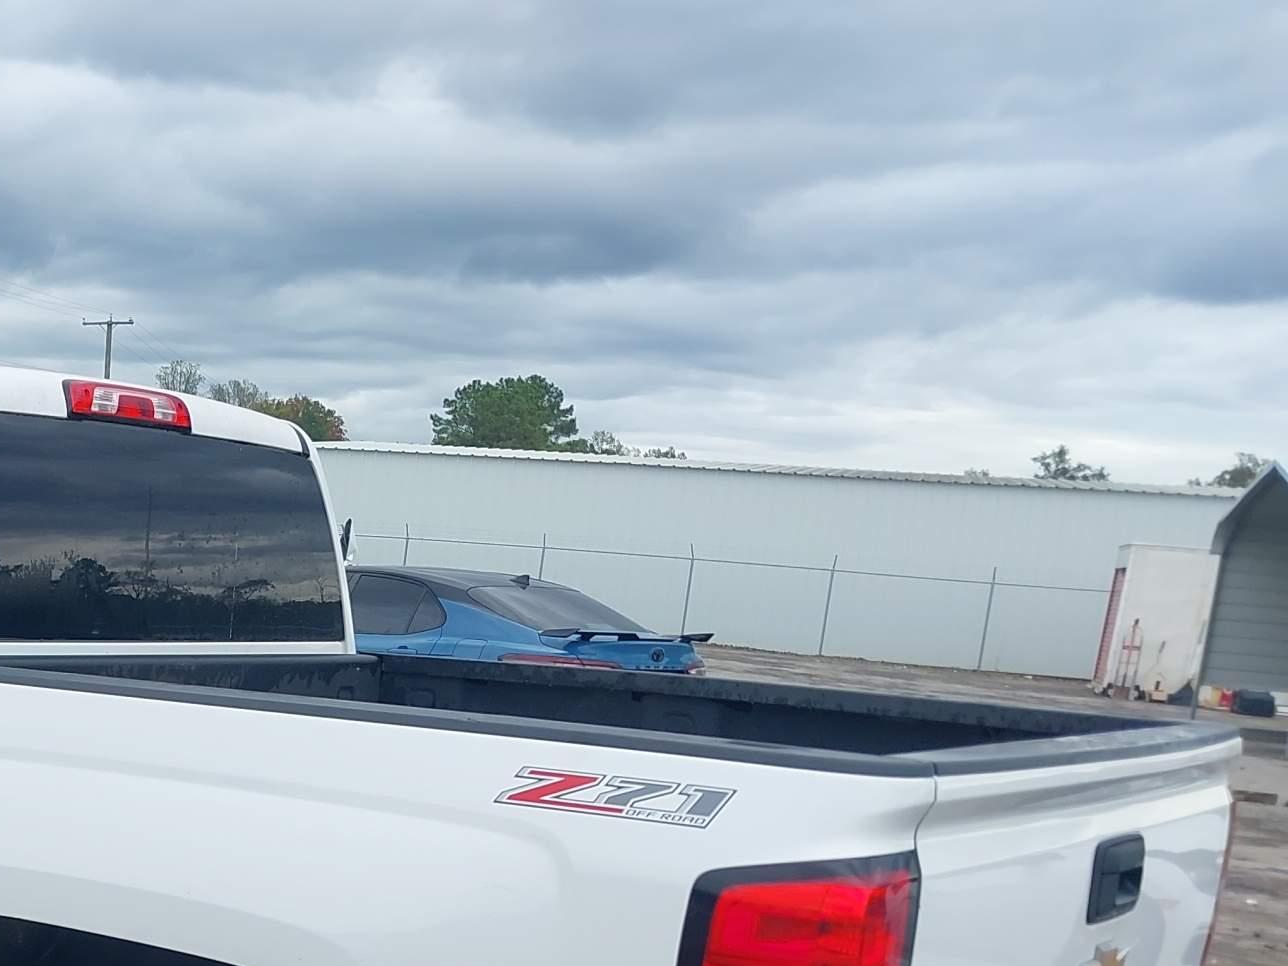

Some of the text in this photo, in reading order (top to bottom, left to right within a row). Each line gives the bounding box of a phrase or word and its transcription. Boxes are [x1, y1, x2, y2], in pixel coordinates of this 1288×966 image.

[494, 766, 738, 822] Z71
[624, 808, 707, 826] OFF ROAD
